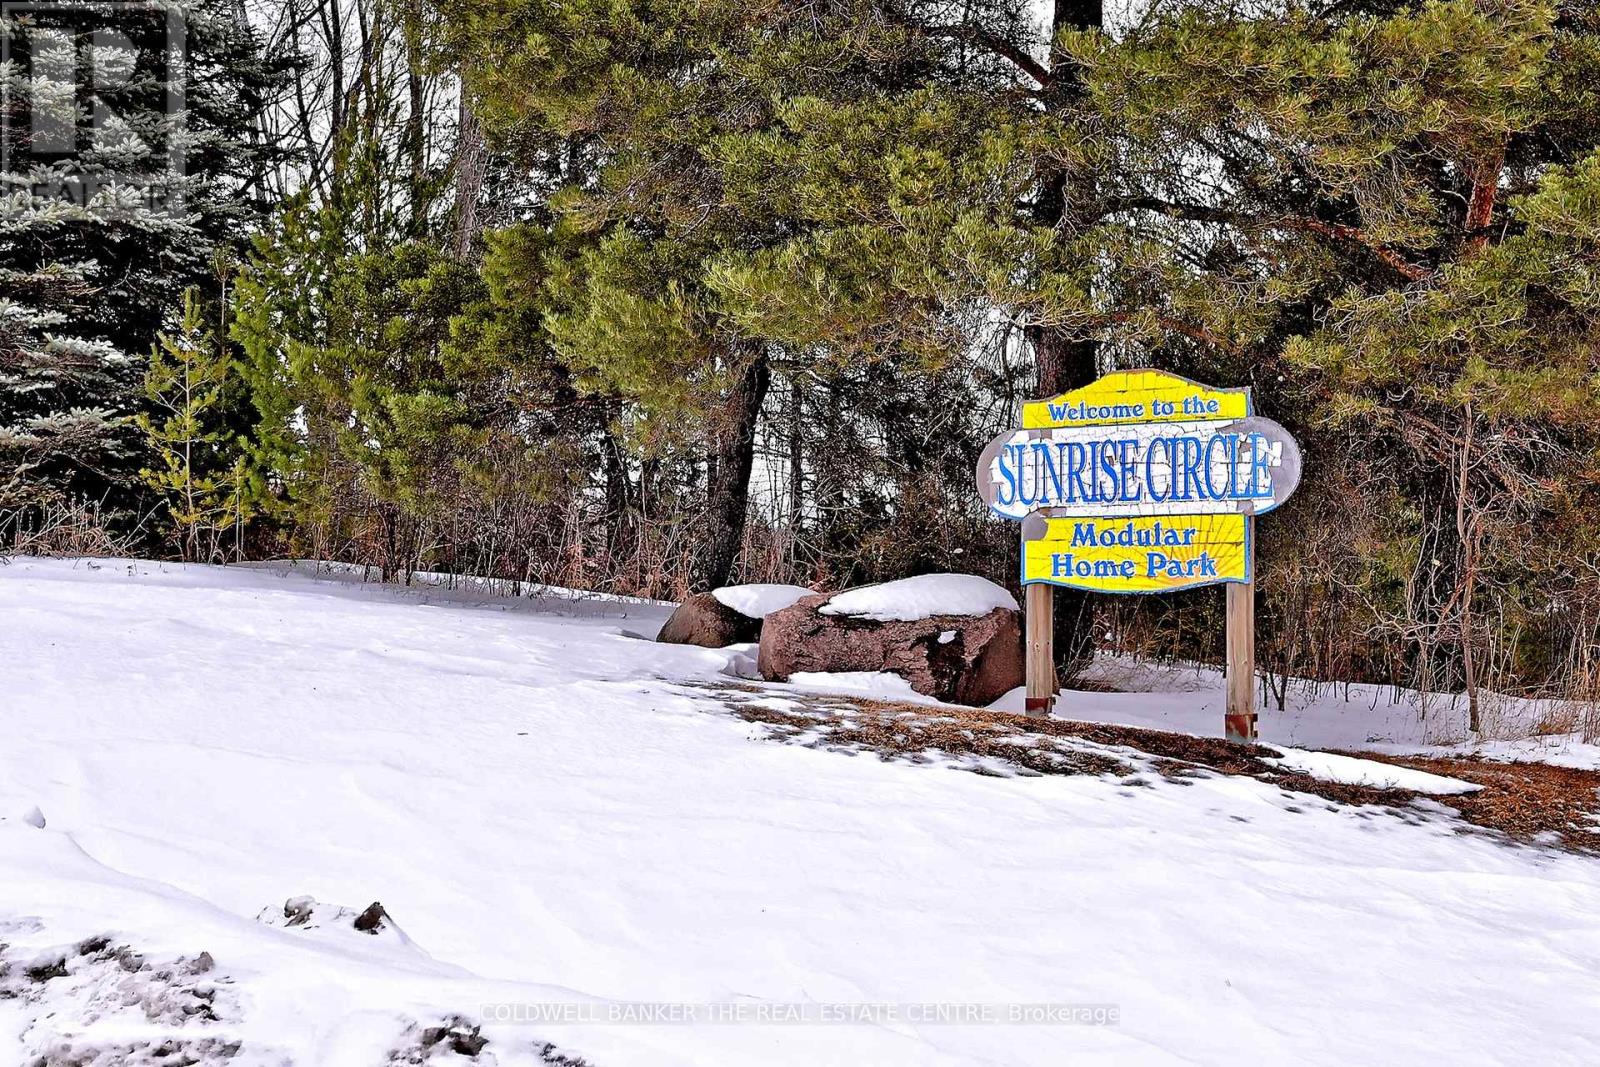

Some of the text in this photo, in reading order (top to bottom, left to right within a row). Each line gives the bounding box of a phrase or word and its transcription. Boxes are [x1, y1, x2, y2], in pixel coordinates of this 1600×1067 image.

[1047, 395, 1219, 421] Welcome to the
[996, 431, 1275, 506] SUNRISE CIRCLE
[1070, 521, 1196, 548] Modular
[1050, 551, 1218, 578] Home Park
